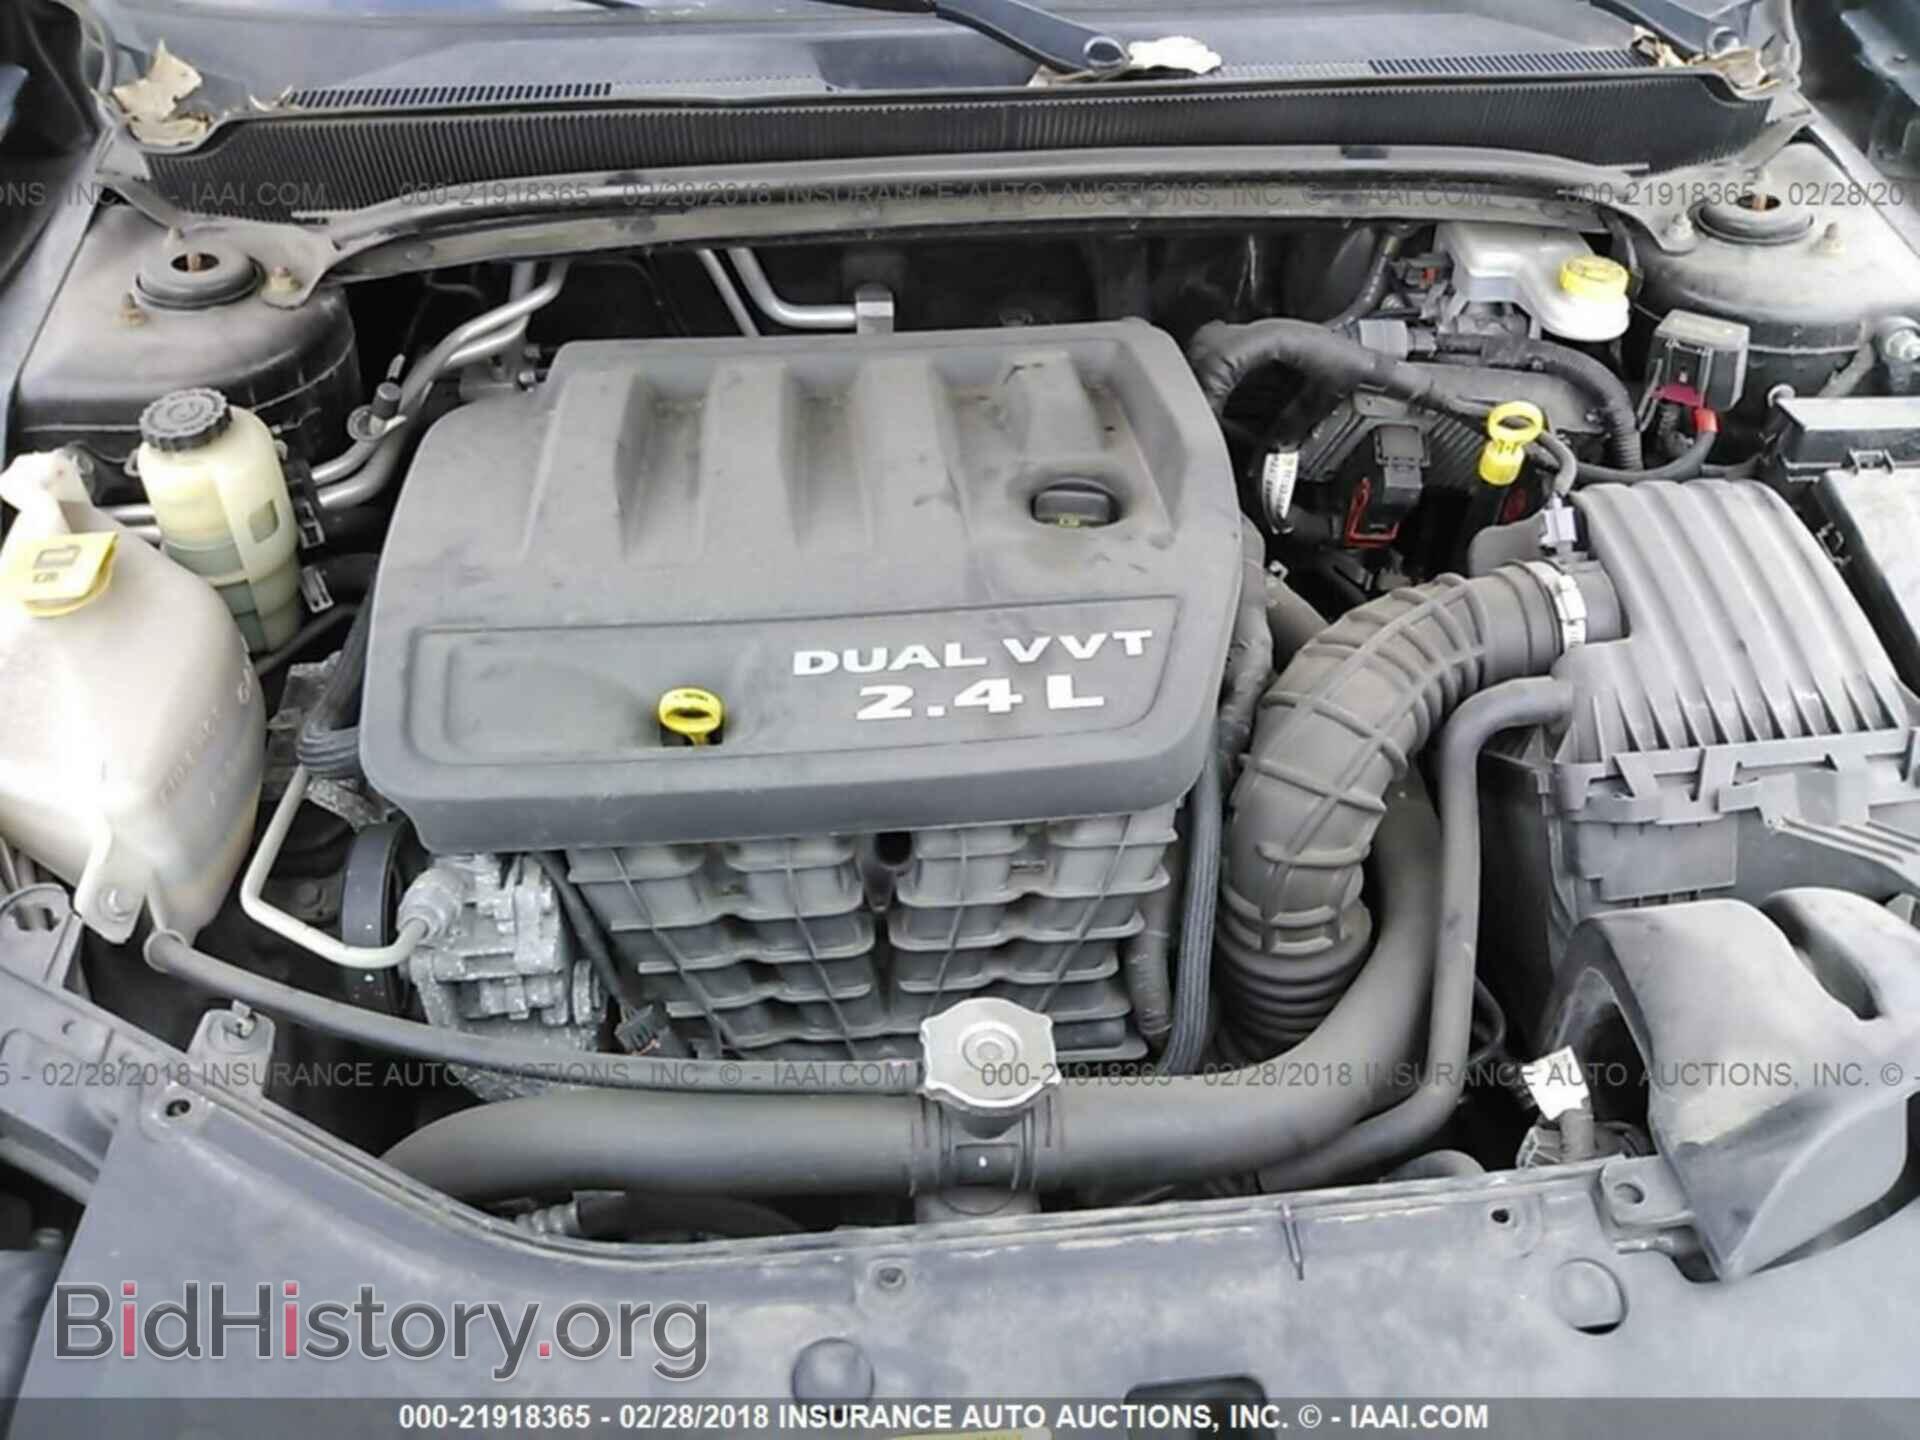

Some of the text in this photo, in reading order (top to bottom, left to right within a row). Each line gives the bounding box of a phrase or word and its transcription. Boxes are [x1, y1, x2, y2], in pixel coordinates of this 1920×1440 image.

[793, 630, 1152, 675] DUAL VVT
[856, 674, 1104, 720] 2.4 L
